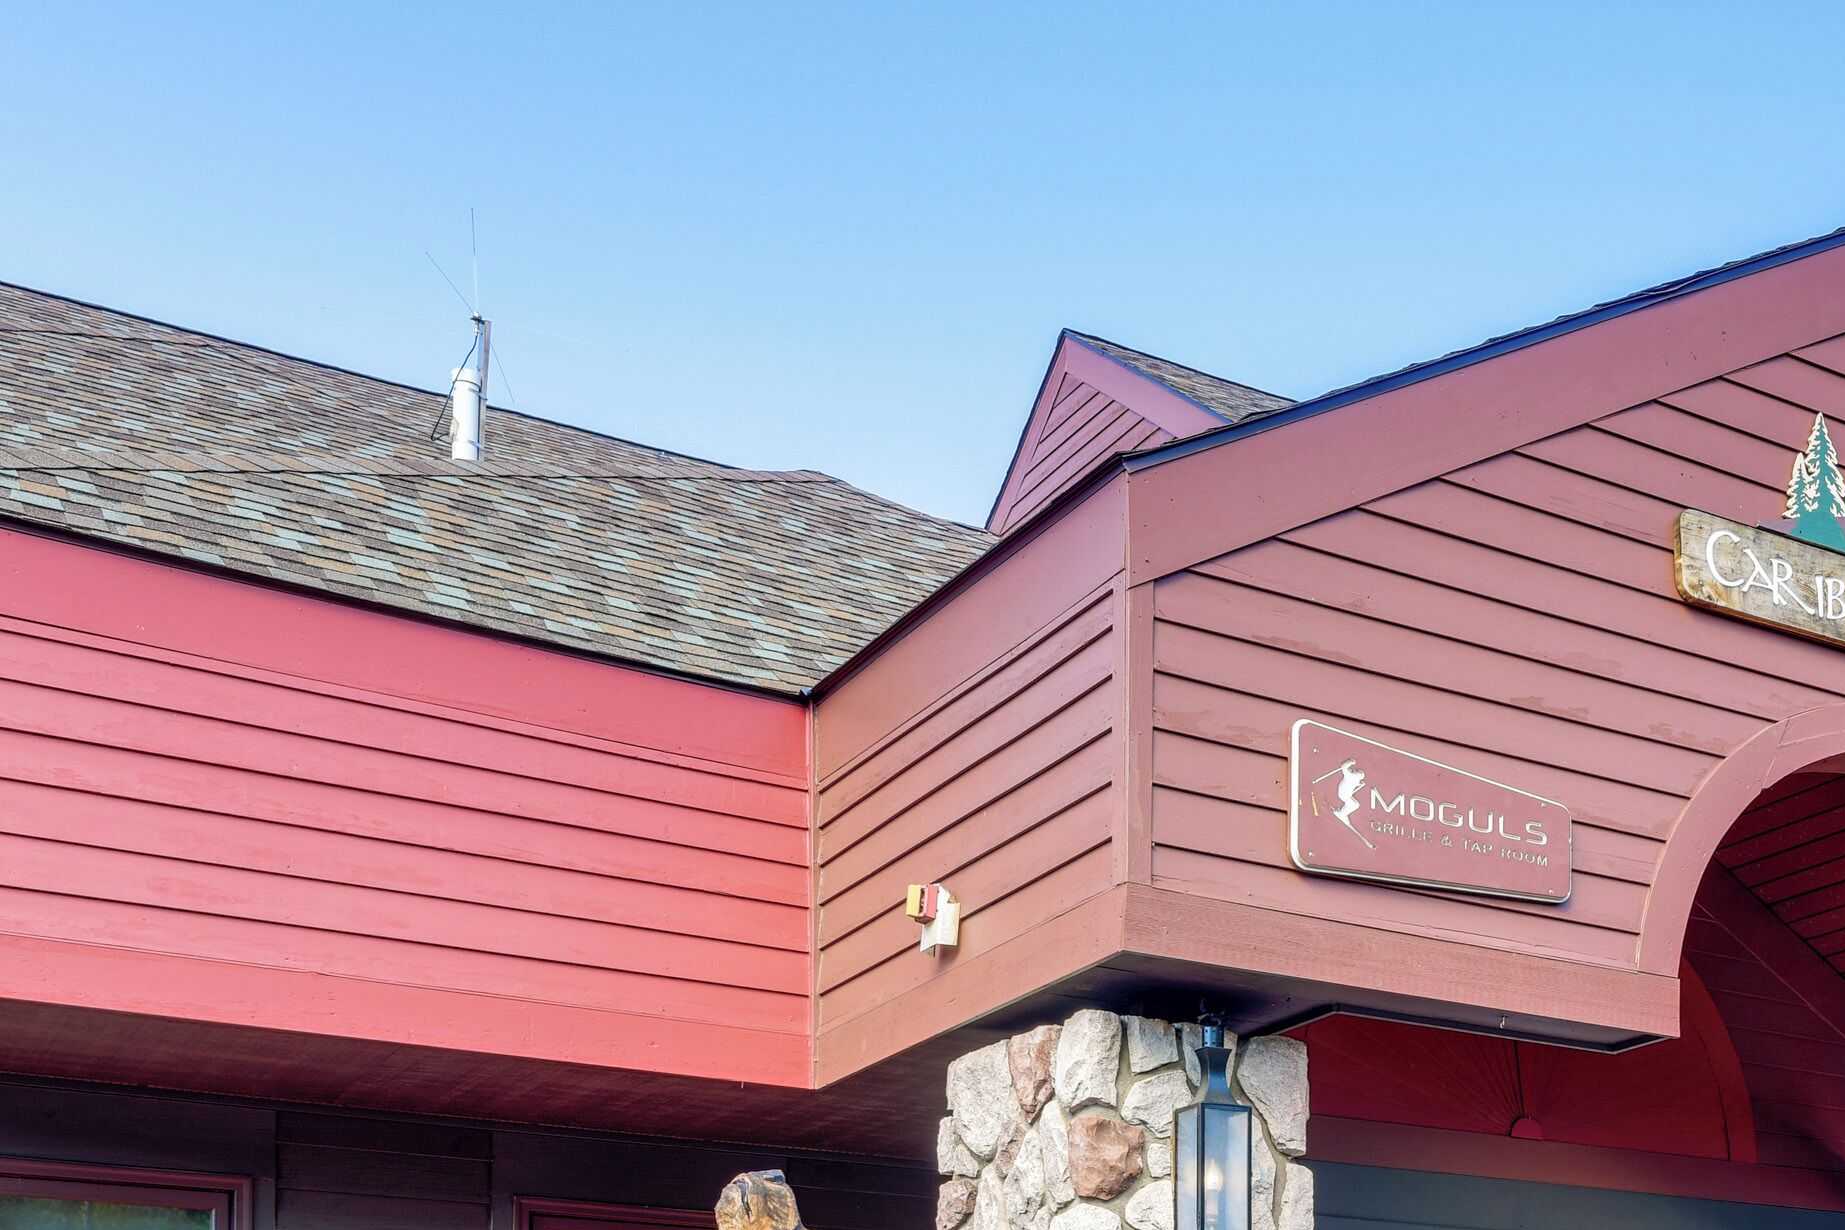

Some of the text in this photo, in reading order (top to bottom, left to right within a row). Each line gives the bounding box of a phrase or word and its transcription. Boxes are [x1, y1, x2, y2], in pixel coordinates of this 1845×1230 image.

[1369, 786, 1549, 847] MOGULS
[1370, 818, 1549, 867] GRILLE & TAP ROOM
